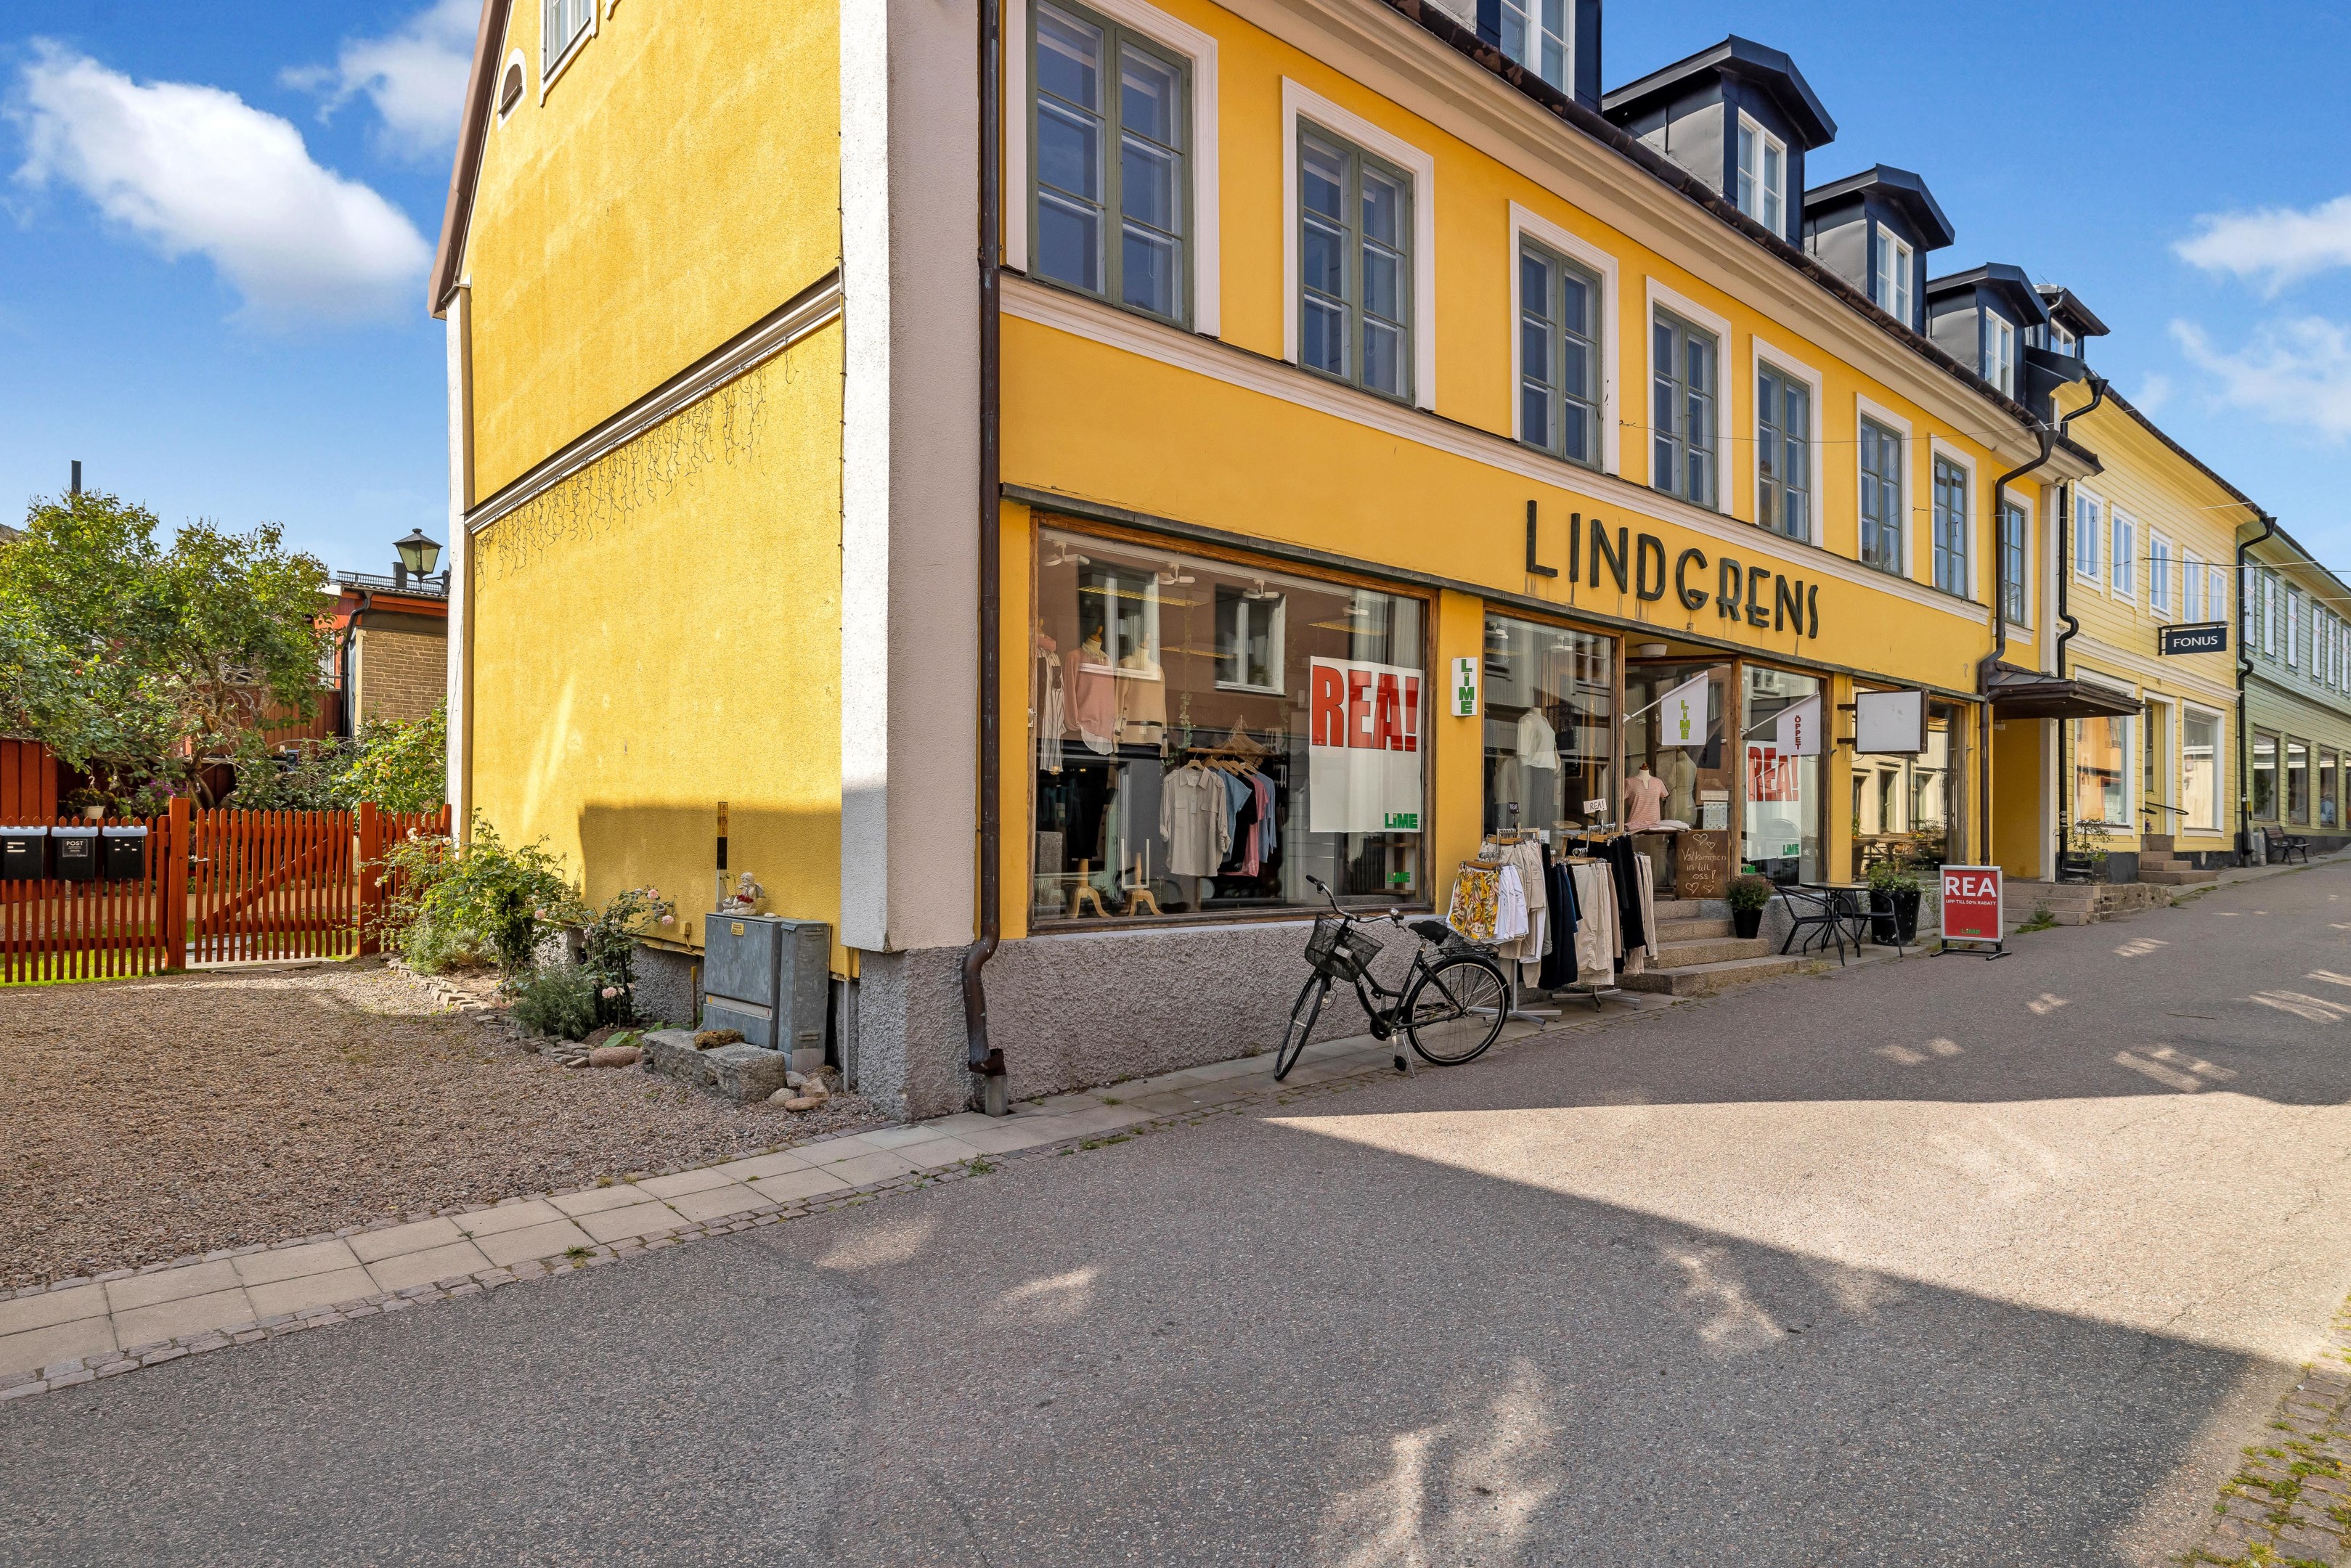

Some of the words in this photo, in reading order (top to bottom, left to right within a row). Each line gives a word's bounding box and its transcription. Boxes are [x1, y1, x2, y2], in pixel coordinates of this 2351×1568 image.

[1526, 499, 1819, 639] LINDGRENS
[2173, 635, 2218, 648] FONUS
[1311, 664, 1419, 752] REA!
[1748, 746, 1799, 801] REA!
[1590, 800, 1605, 810] REA!
[1945, 876, 1997, 897] REA
